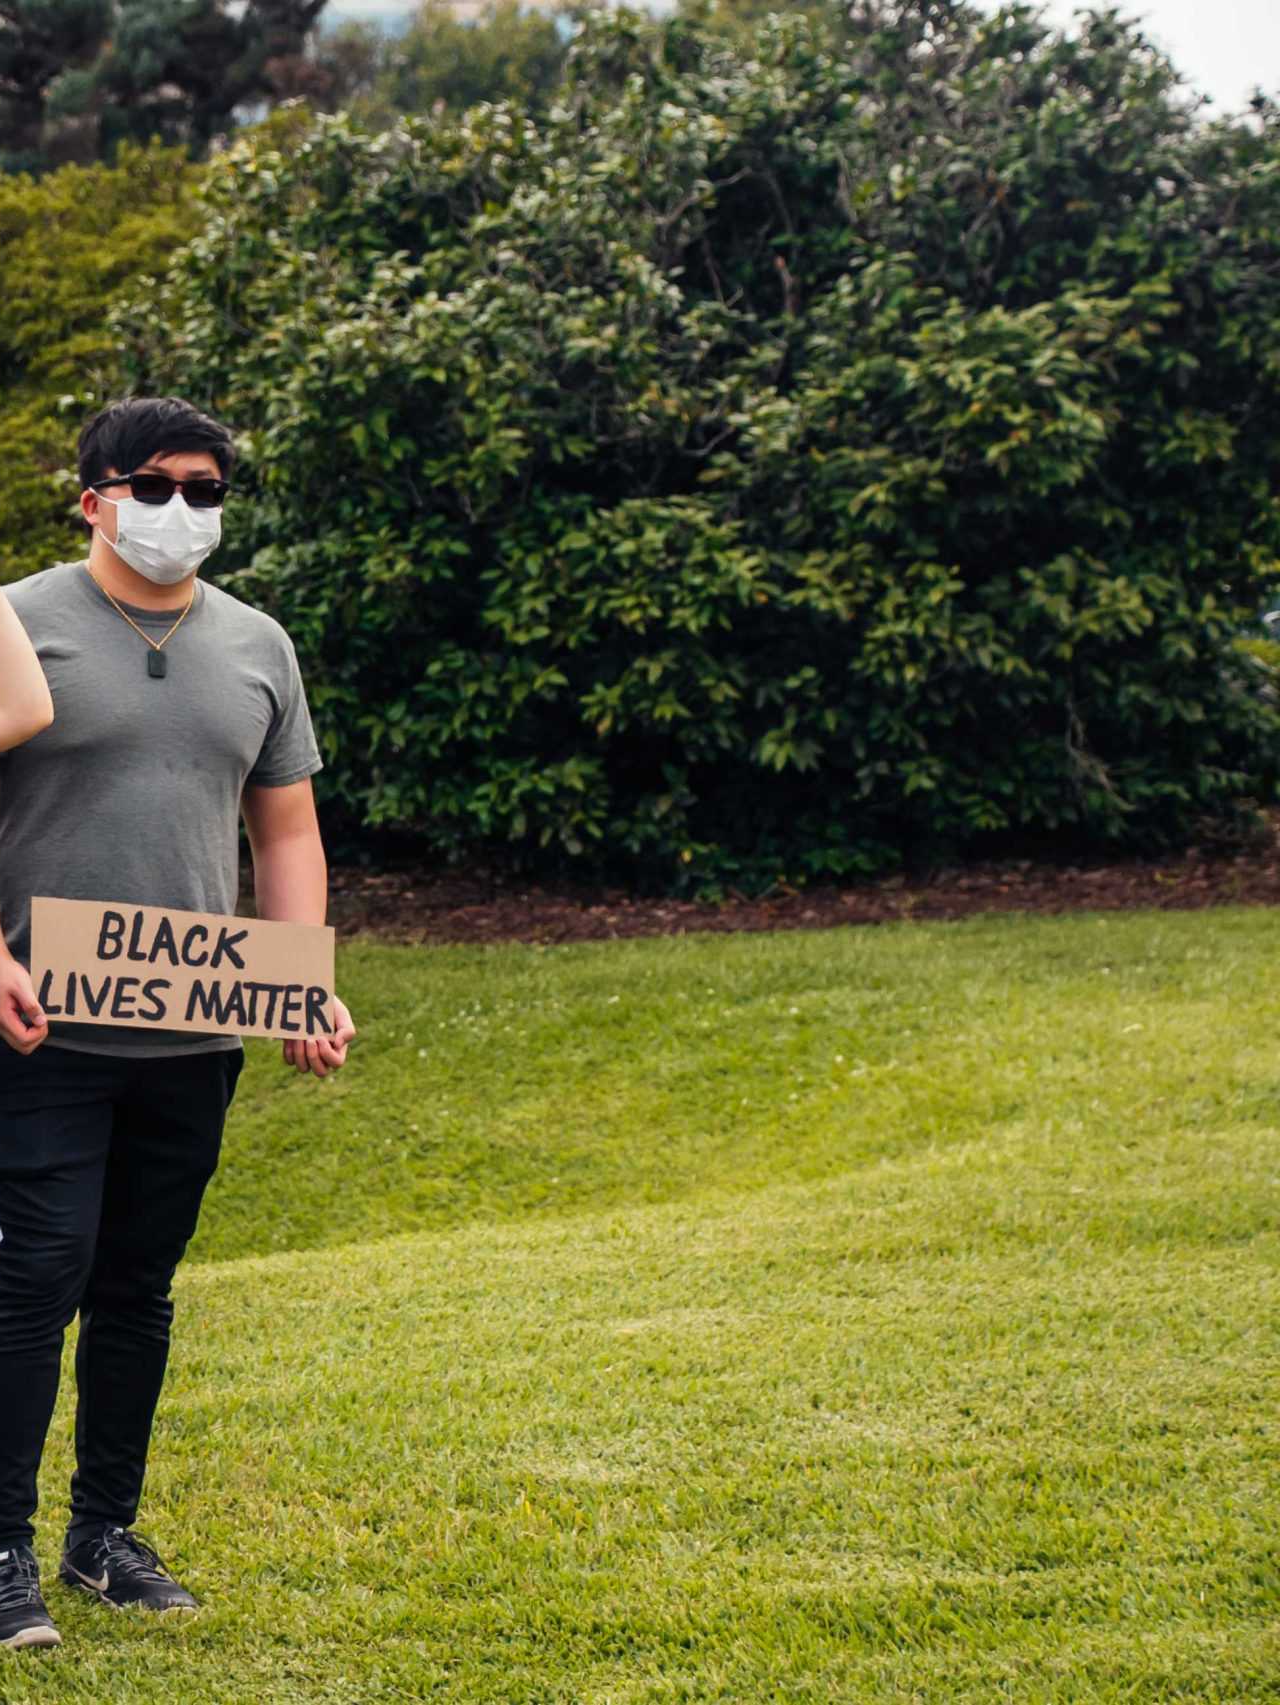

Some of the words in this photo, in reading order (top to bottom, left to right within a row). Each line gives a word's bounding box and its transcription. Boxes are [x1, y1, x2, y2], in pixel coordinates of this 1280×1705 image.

[96, 910, 248, 969] BLACK
[38, 969, 172, 1021] LIVES
[184, 978, 332, 1035] MATTER
